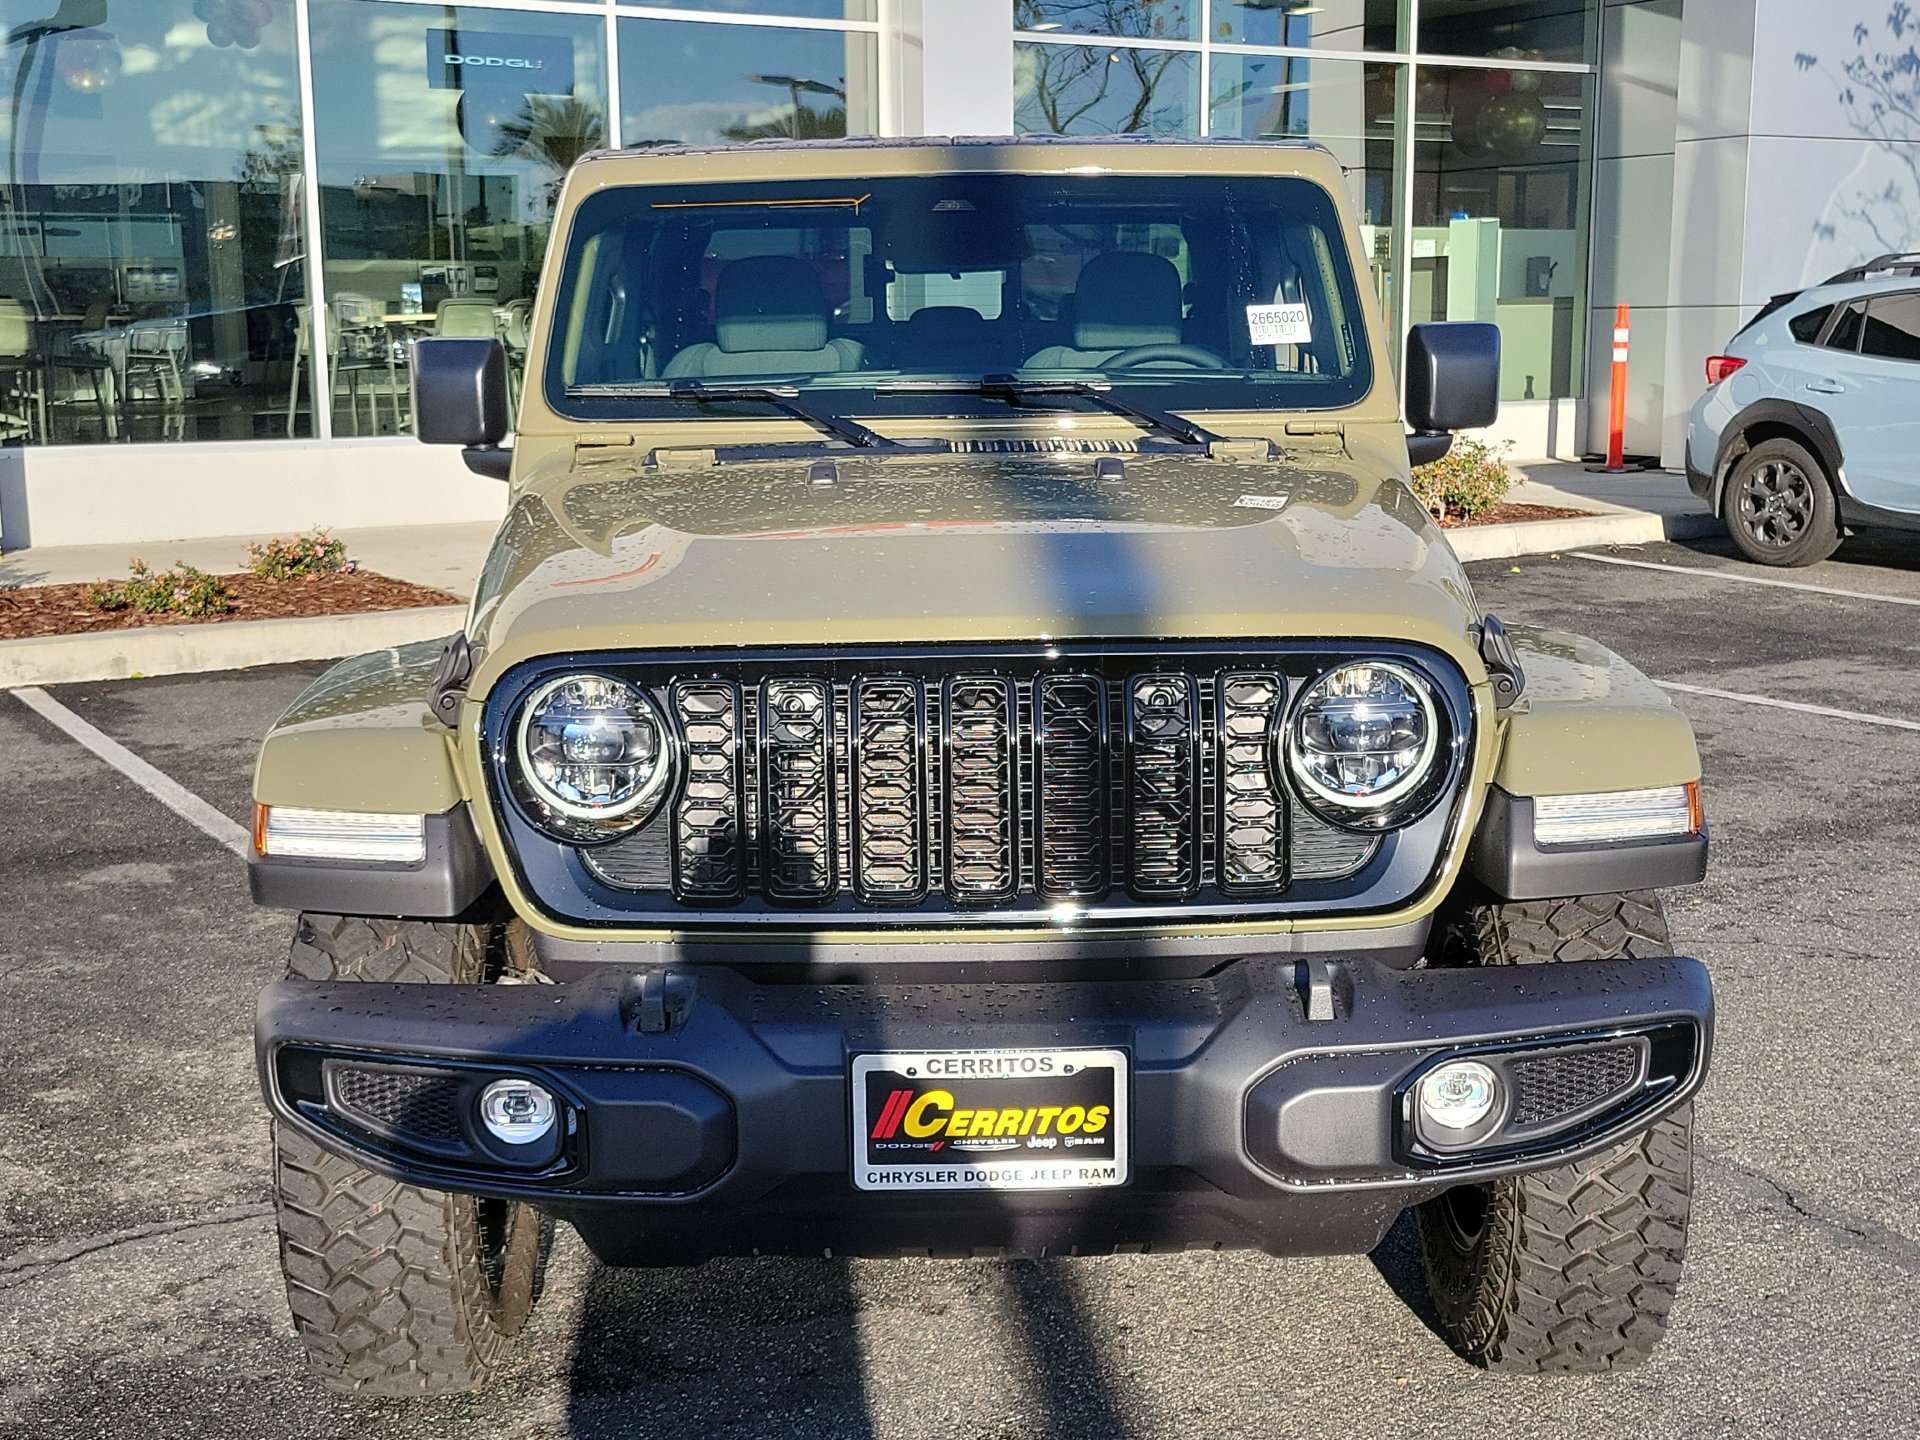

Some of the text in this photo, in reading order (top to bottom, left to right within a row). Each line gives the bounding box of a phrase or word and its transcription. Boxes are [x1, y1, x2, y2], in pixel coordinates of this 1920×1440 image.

[1250, 310, 1305, 325] 2665020
[926, 1057, 1054, 1075] CERRITOS
[903, 1089, 1110, 1139] CERRITOS
[1027, 1136, 1058, 1150] Jeep
[1074, 1137, 1105, 1145] RAM
[867, 1167, 1116, 1184] CHRYSLER DODGE JEEP RAM
